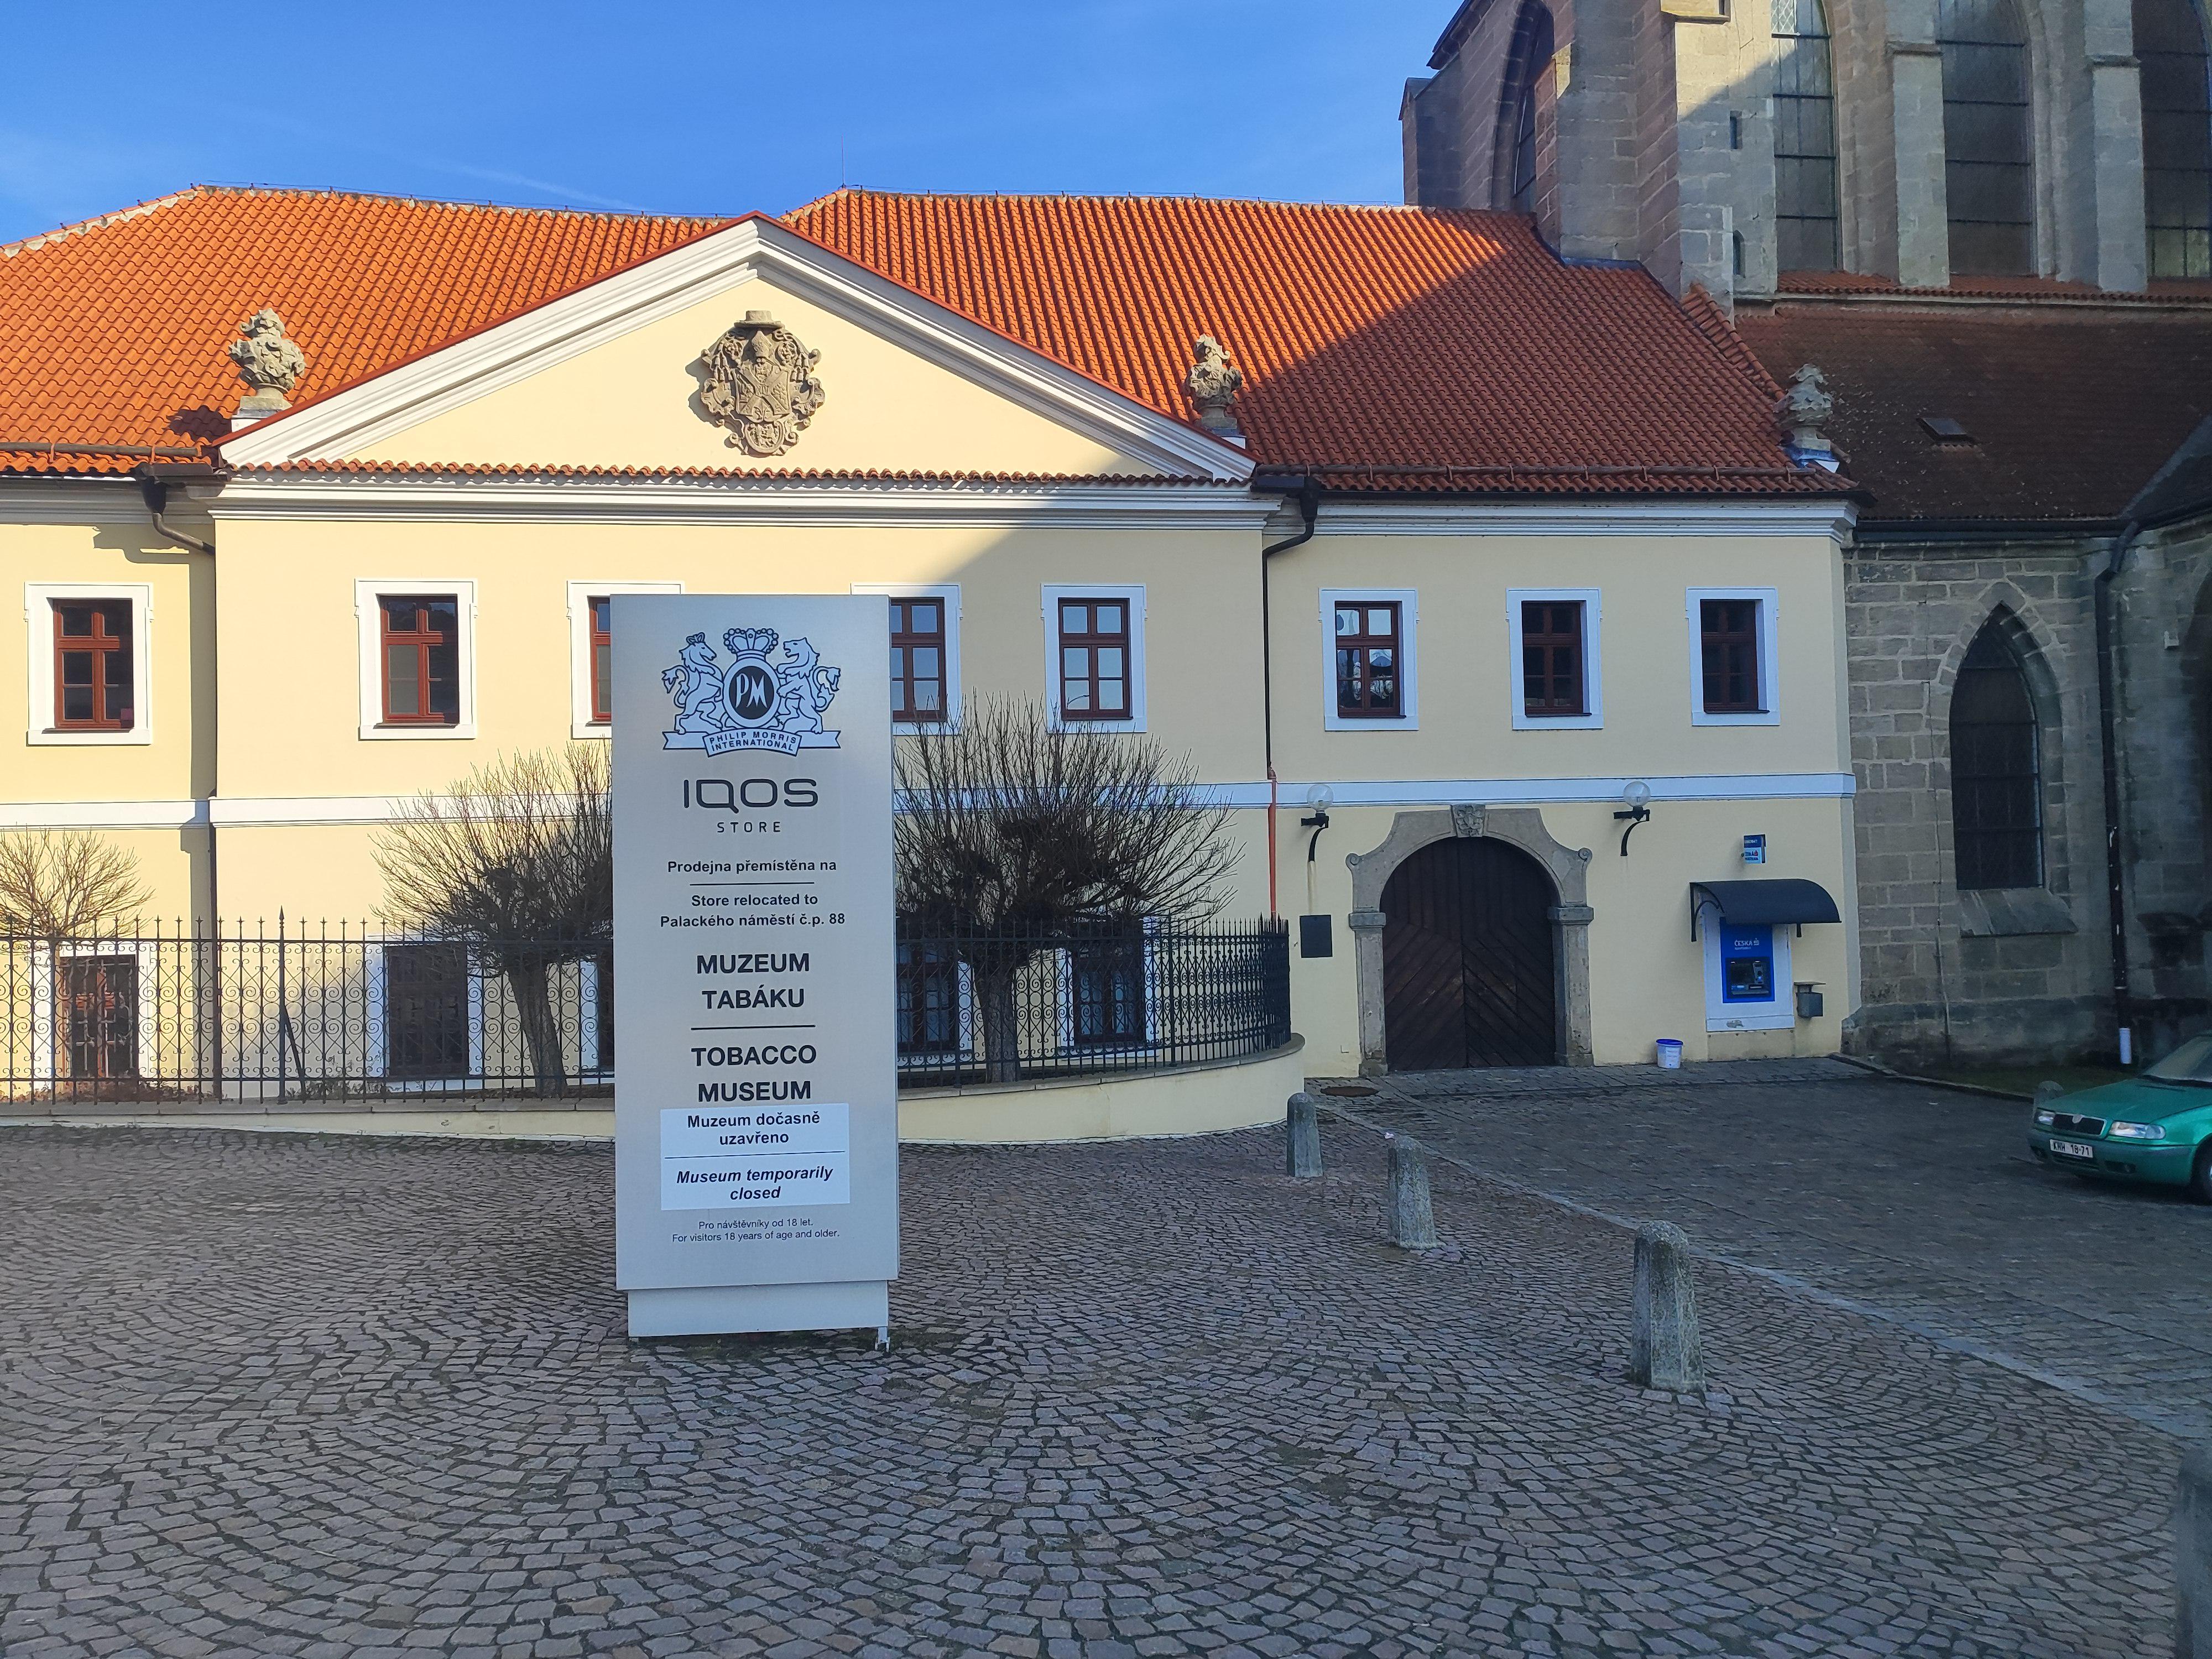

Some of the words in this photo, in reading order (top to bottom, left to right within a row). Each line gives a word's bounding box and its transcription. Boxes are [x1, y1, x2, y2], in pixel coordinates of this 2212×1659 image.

[735, 673, 768, 708] PM
[709, 731, 747, 744] PHILIP
[753, 731, 797, 744] MORRIS
[711, 739, 794, 752] INTERNATIONAL
[684, 778, 818, 814] IQOS
[717, 821, 781, 833] STORE
[667, 860, 731, 875] Prodejna
[736, 859, 815, 874] přemístěna
[820, 862, 837, 870] na
[691, 895, 729, 907] Store
[734, 893, 800, 906] relocated
[804, 894, 818, 905] to
[660, 915, 734, 927] Palackého
[739, 913, 795, 926] náměstí
[799, 913, 825, 927] č.p.
[829, 912, 845, 925] 88
[697, 953, 810, 974] MUZEUM
[701, 984, 804, 1009] TABÁKU
[691, 1045, 817, 1067] TOBACCO
[698, 1081, 811, 1102] MUSEUM
[687, 1115, 751, 1128] Muzeum
[756, 1110, 820, 1126] dočasně
[719, 1131, 789, 1145] uzavřeno
[2070, 1144, 2089, 1156] 18-71
[676, 1171, 742, 1184] Museum
[747, 1165, 834, 1183] temporarily
[730, 1186, 781, 1200] closed
[698, 1221, 714, 1230] Pro
[717, 1219, 770, 1229] návštěvníky
[771, 1218, 784, 1227] od
[786, 1218, 797, 1227] 18
[800, 1218, 813, 1226] let.
[672, 1234, 688, 1243] For
[690, 1233, 722, 1241] visitors
[724, 1232, 735, 1240] 18
[737, 1233, 763, 1243] years
[764, 1230, 774, 1239] of
[776, 1232, 793, 1241] age
[795, 1229, 812, 1238] and
[815, 1229, 840, 1238] older.
